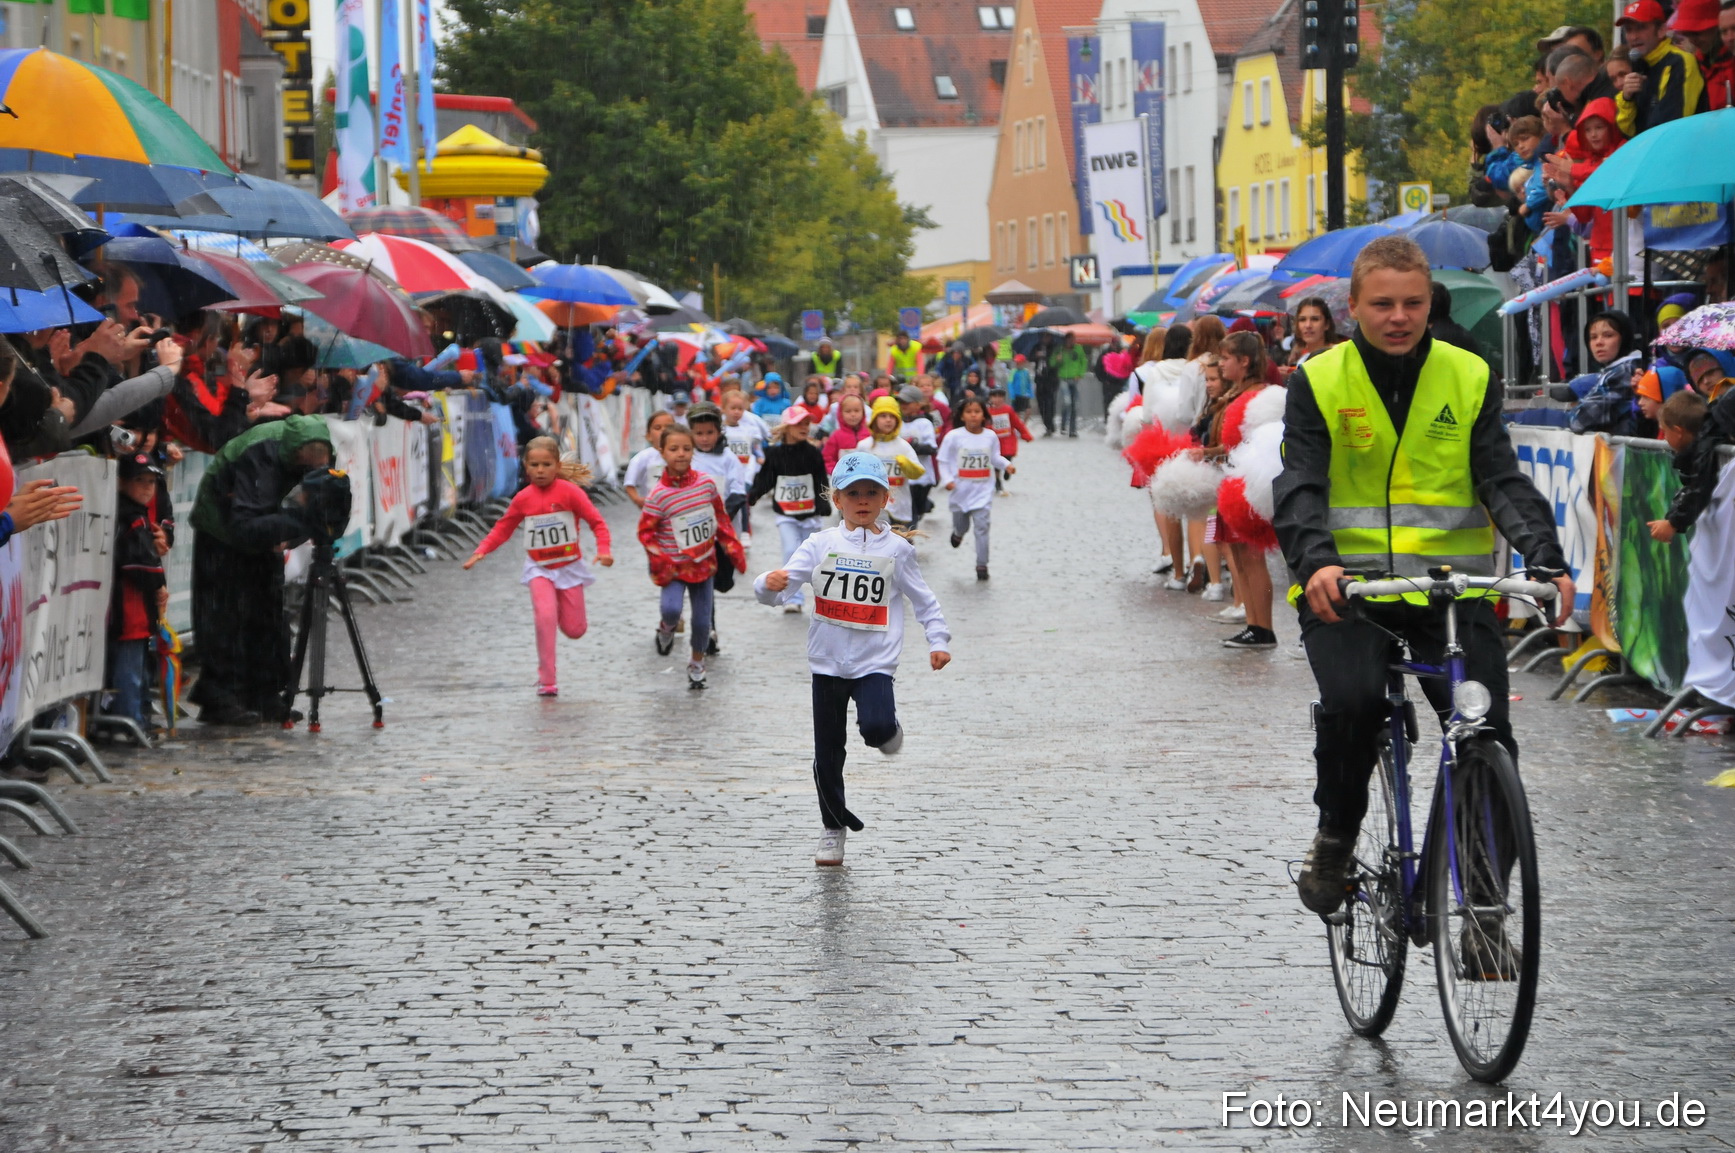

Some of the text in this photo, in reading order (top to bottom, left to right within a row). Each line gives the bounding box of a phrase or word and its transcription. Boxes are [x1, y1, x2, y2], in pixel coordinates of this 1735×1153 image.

[884, 463, 900, 475] 76
[962, 456, 989, 468] 7212
[780, 485, 808, 500] 7302
[528, 525, 568, 547] 7101
[836, 557, 872, 568] BOCK
[821, 570, 885, 603] 7169
[819, 600, 877, 621] THERESA
